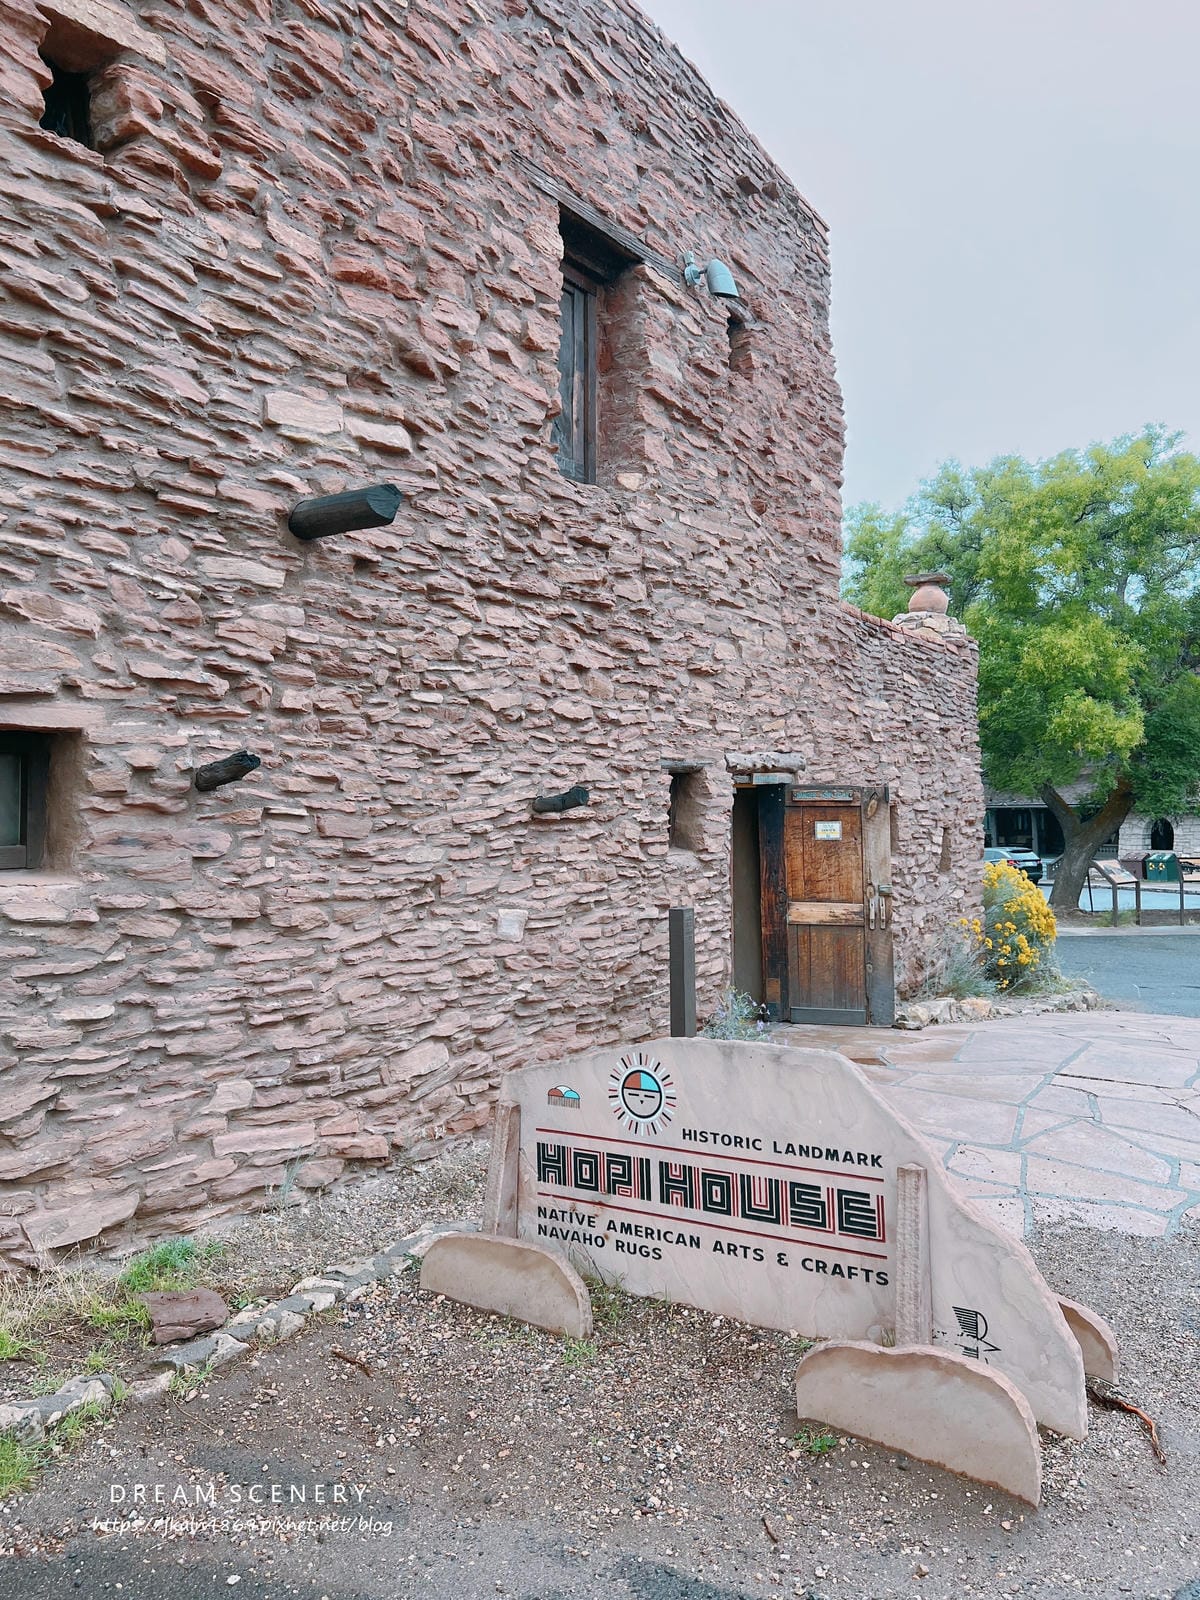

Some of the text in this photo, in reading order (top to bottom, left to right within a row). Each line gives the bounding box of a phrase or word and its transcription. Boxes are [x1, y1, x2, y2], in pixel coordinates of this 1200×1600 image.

[682, 1128, 884, 1168] HISTORIC LANDMARK
[537, 1142, 886, 1243] HOPI HOUSE
[537, 1223, 663, 1261] NAVAHO RUGS
[537, 1206, 889, 1286] NATIVE AMERICAN ARTS & CRAFTS
